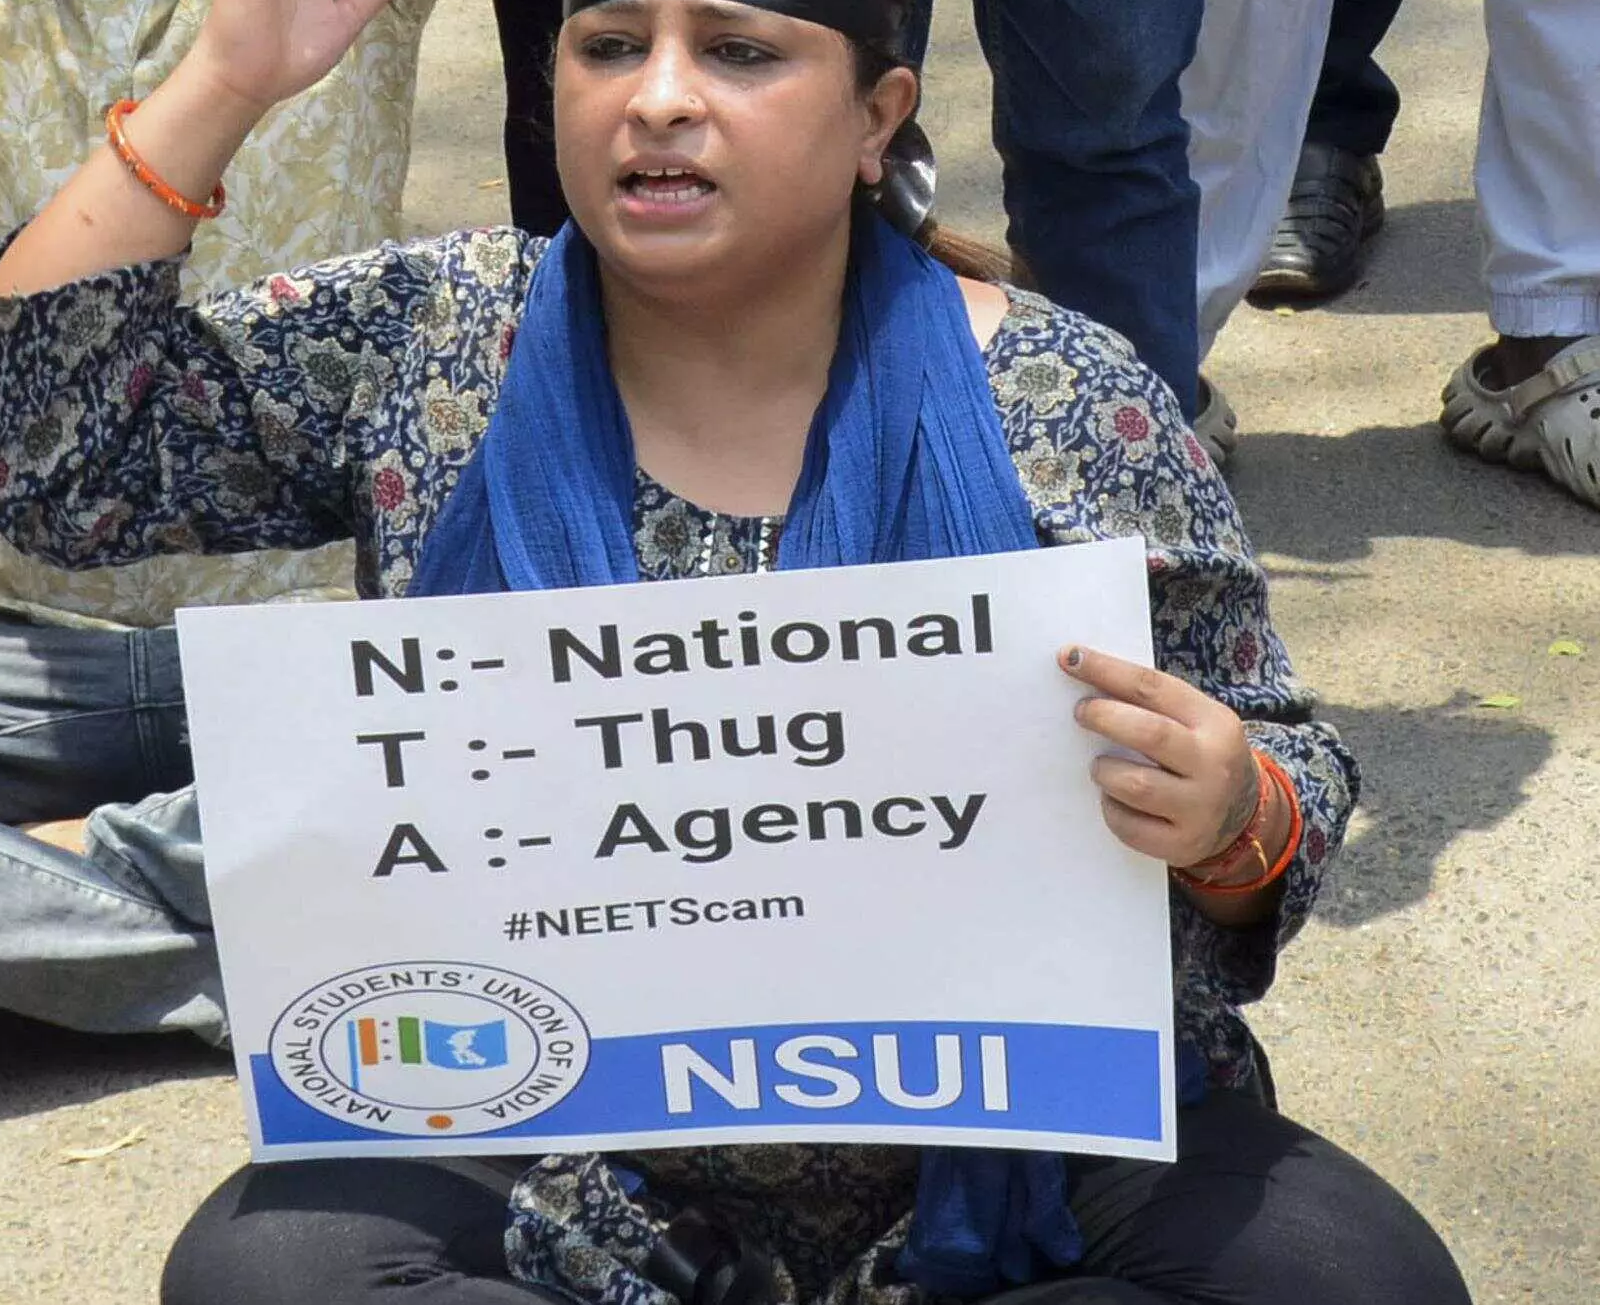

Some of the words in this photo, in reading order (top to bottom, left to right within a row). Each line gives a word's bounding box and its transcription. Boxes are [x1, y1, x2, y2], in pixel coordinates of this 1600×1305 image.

[549, 594, 992, 683] National
[575, 708, 845, 769] Thug
[595, 794, 987, 863] Agency
[503, 896, 804, 941] #NEETScam
[483, 978, 569, 1034] UNION
[286, 1036, 391, 1123] NATIONAL
[547, 1040, 574, 1069] OF
[660, 1033, 1011, 1114] NSUI
[483, 1073, 564, 1118] INDIA
